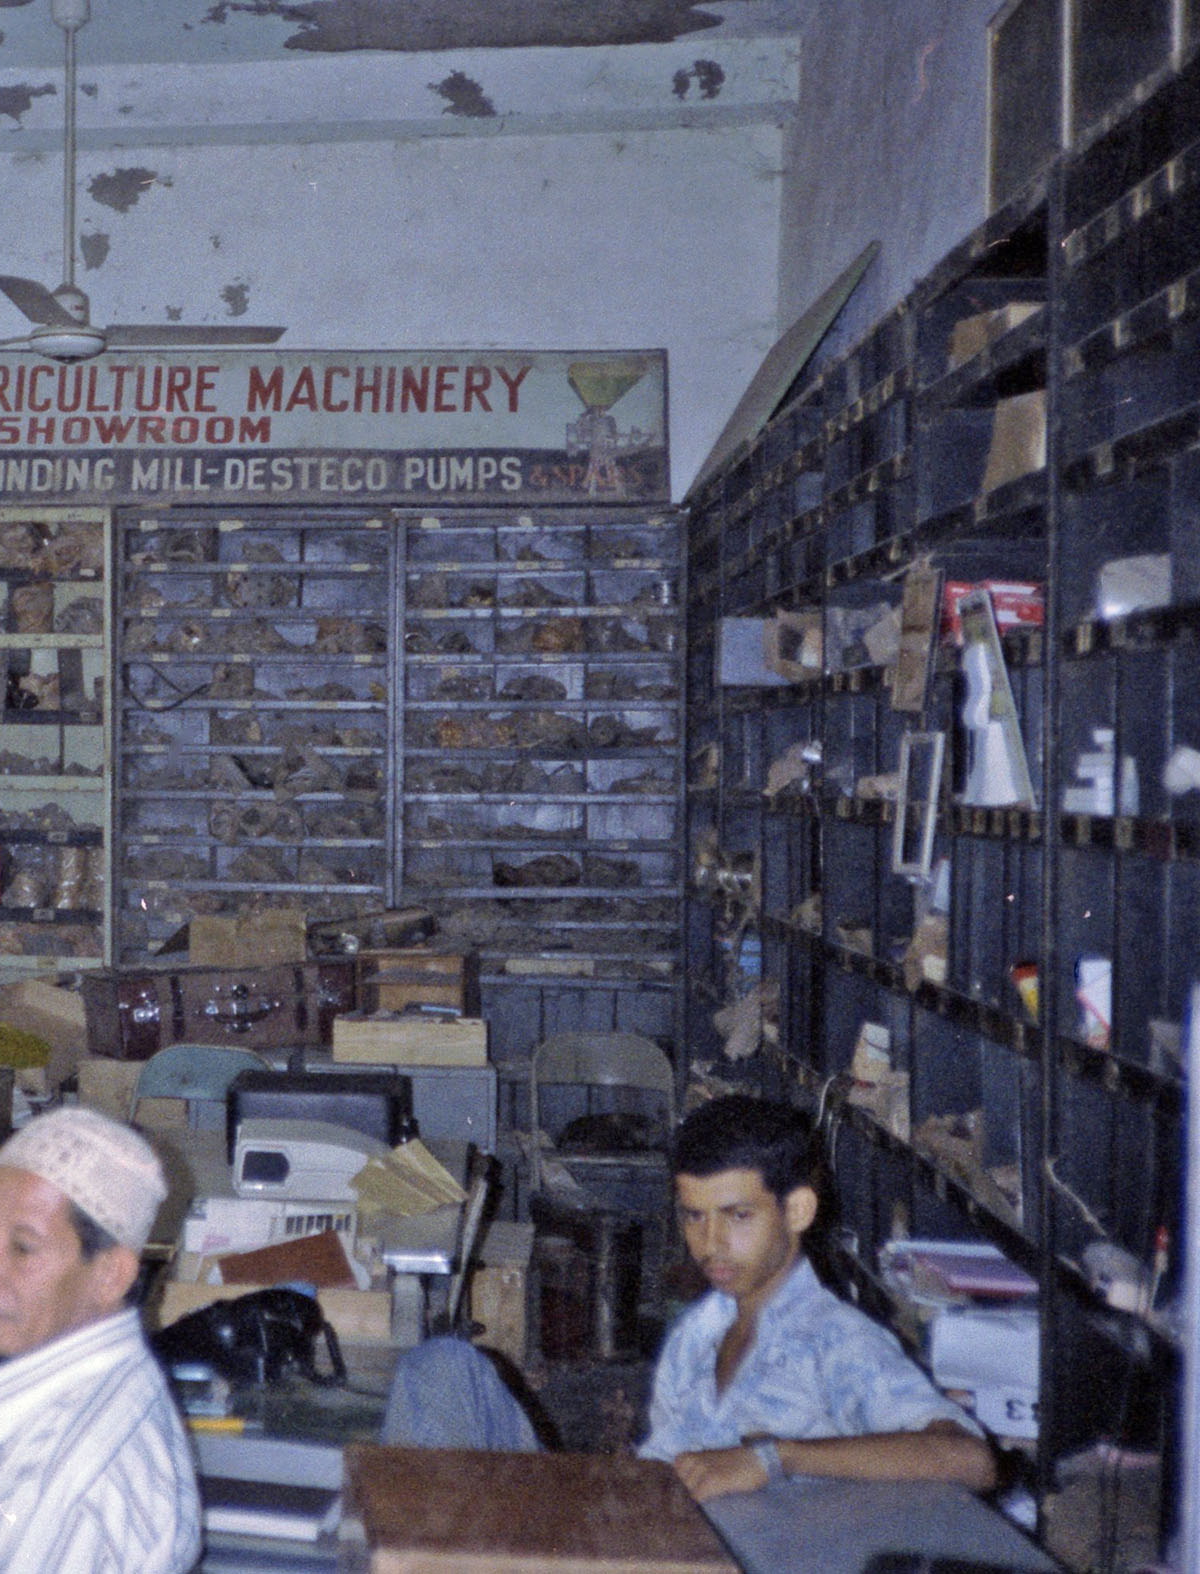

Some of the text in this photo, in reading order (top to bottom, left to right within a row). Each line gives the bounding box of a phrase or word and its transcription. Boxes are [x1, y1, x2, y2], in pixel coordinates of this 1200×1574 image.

[247, 365, 532, 413] MACHINERY
[130, 456, 388, 492] MILL-DESTECO
[404, 456, 523, 491] PUMPS
